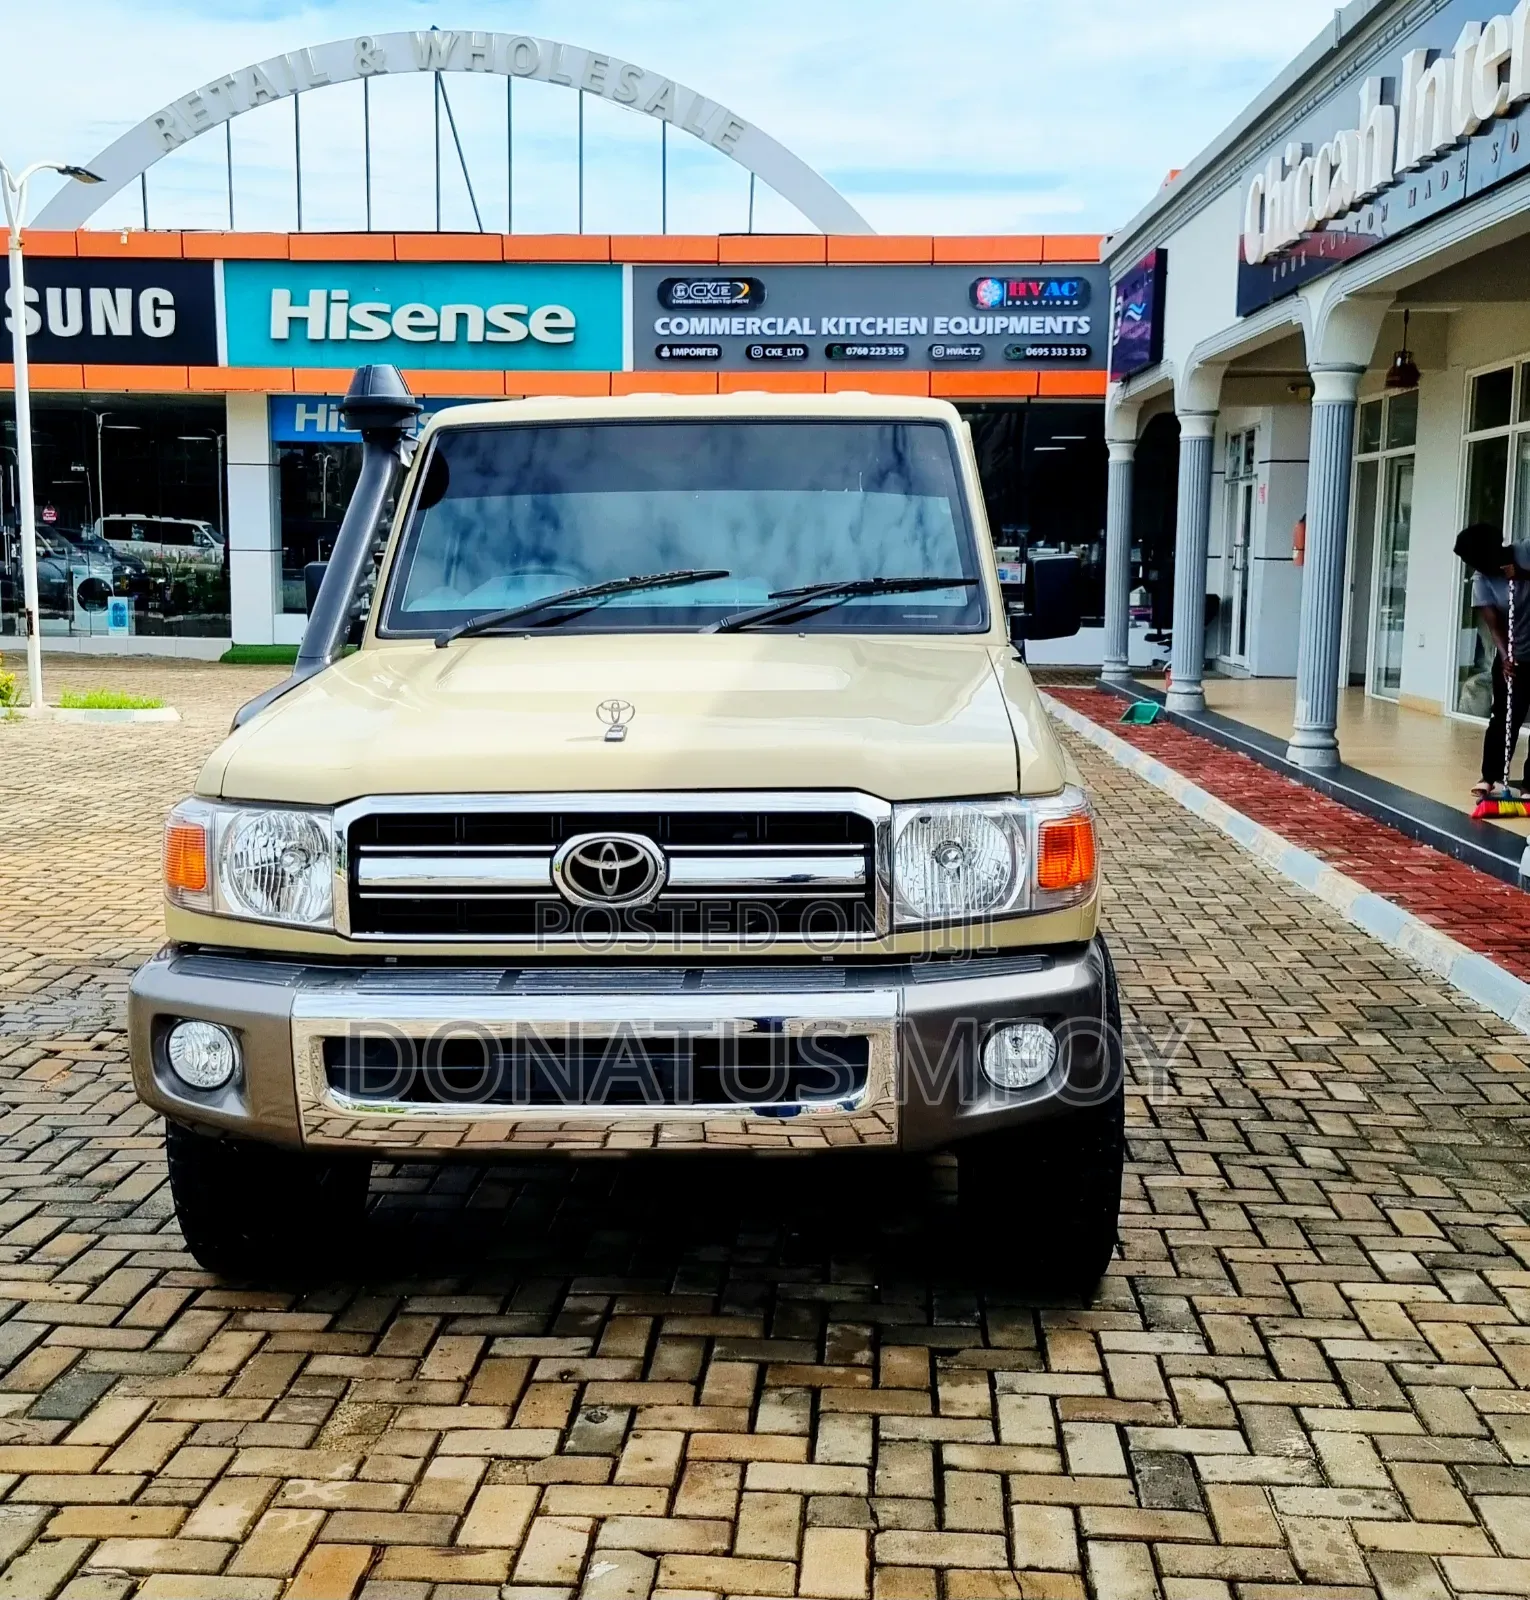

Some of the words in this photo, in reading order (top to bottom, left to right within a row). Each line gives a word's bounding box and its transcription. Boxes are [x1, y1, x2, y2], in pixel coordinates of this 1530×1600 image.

[153, 45, 332, 152] RETAIL
[354, 35, 388, 77] &
[410, 30, 748, 155] WHOLESALE
[1008, 281, 1078, 297] HVAC
[270, 288, 577, 343] Hisense
[653, 316, 817, 336] COMMERCIAL
[820, 316, 928, 336] KITCHEN
[933, 315, 1091, 336] EQUIPMENTS
[672, 347, 719, 357] IMPORTER
[869, 346, 887, 356] 223
[887, 346, 905, 356] 355
[1025, 347, 1050, 357] 0695
[1050, 347, 1068, 357] 333
[1069, 347, 1088, 357] 333
